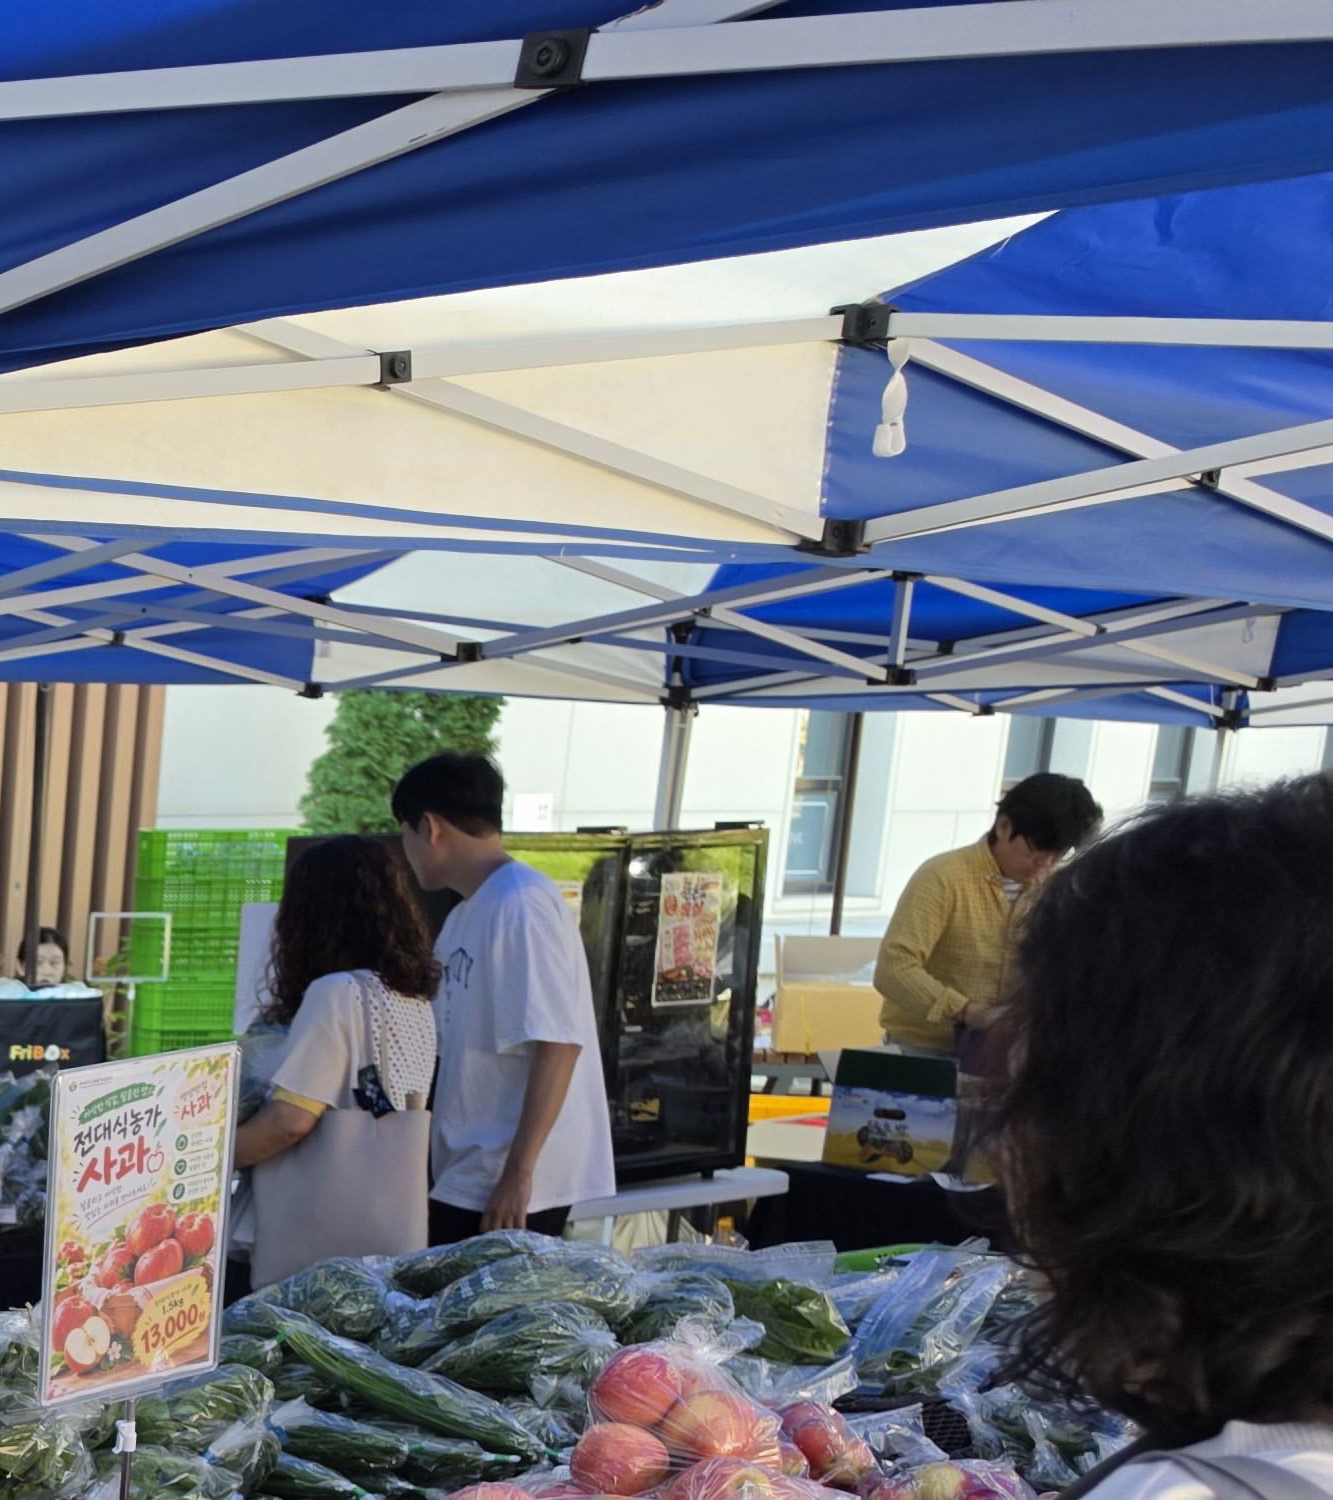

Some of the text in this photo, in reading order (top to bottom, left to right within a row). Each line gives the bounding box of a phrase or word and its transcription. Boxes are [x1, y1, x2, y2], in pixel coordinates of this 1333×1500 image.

[73, 1103, 163, 1158] 전대식농가
[181, 1090, 213, 1121] 사과
[76, 1135, 152, 1194] 사과
